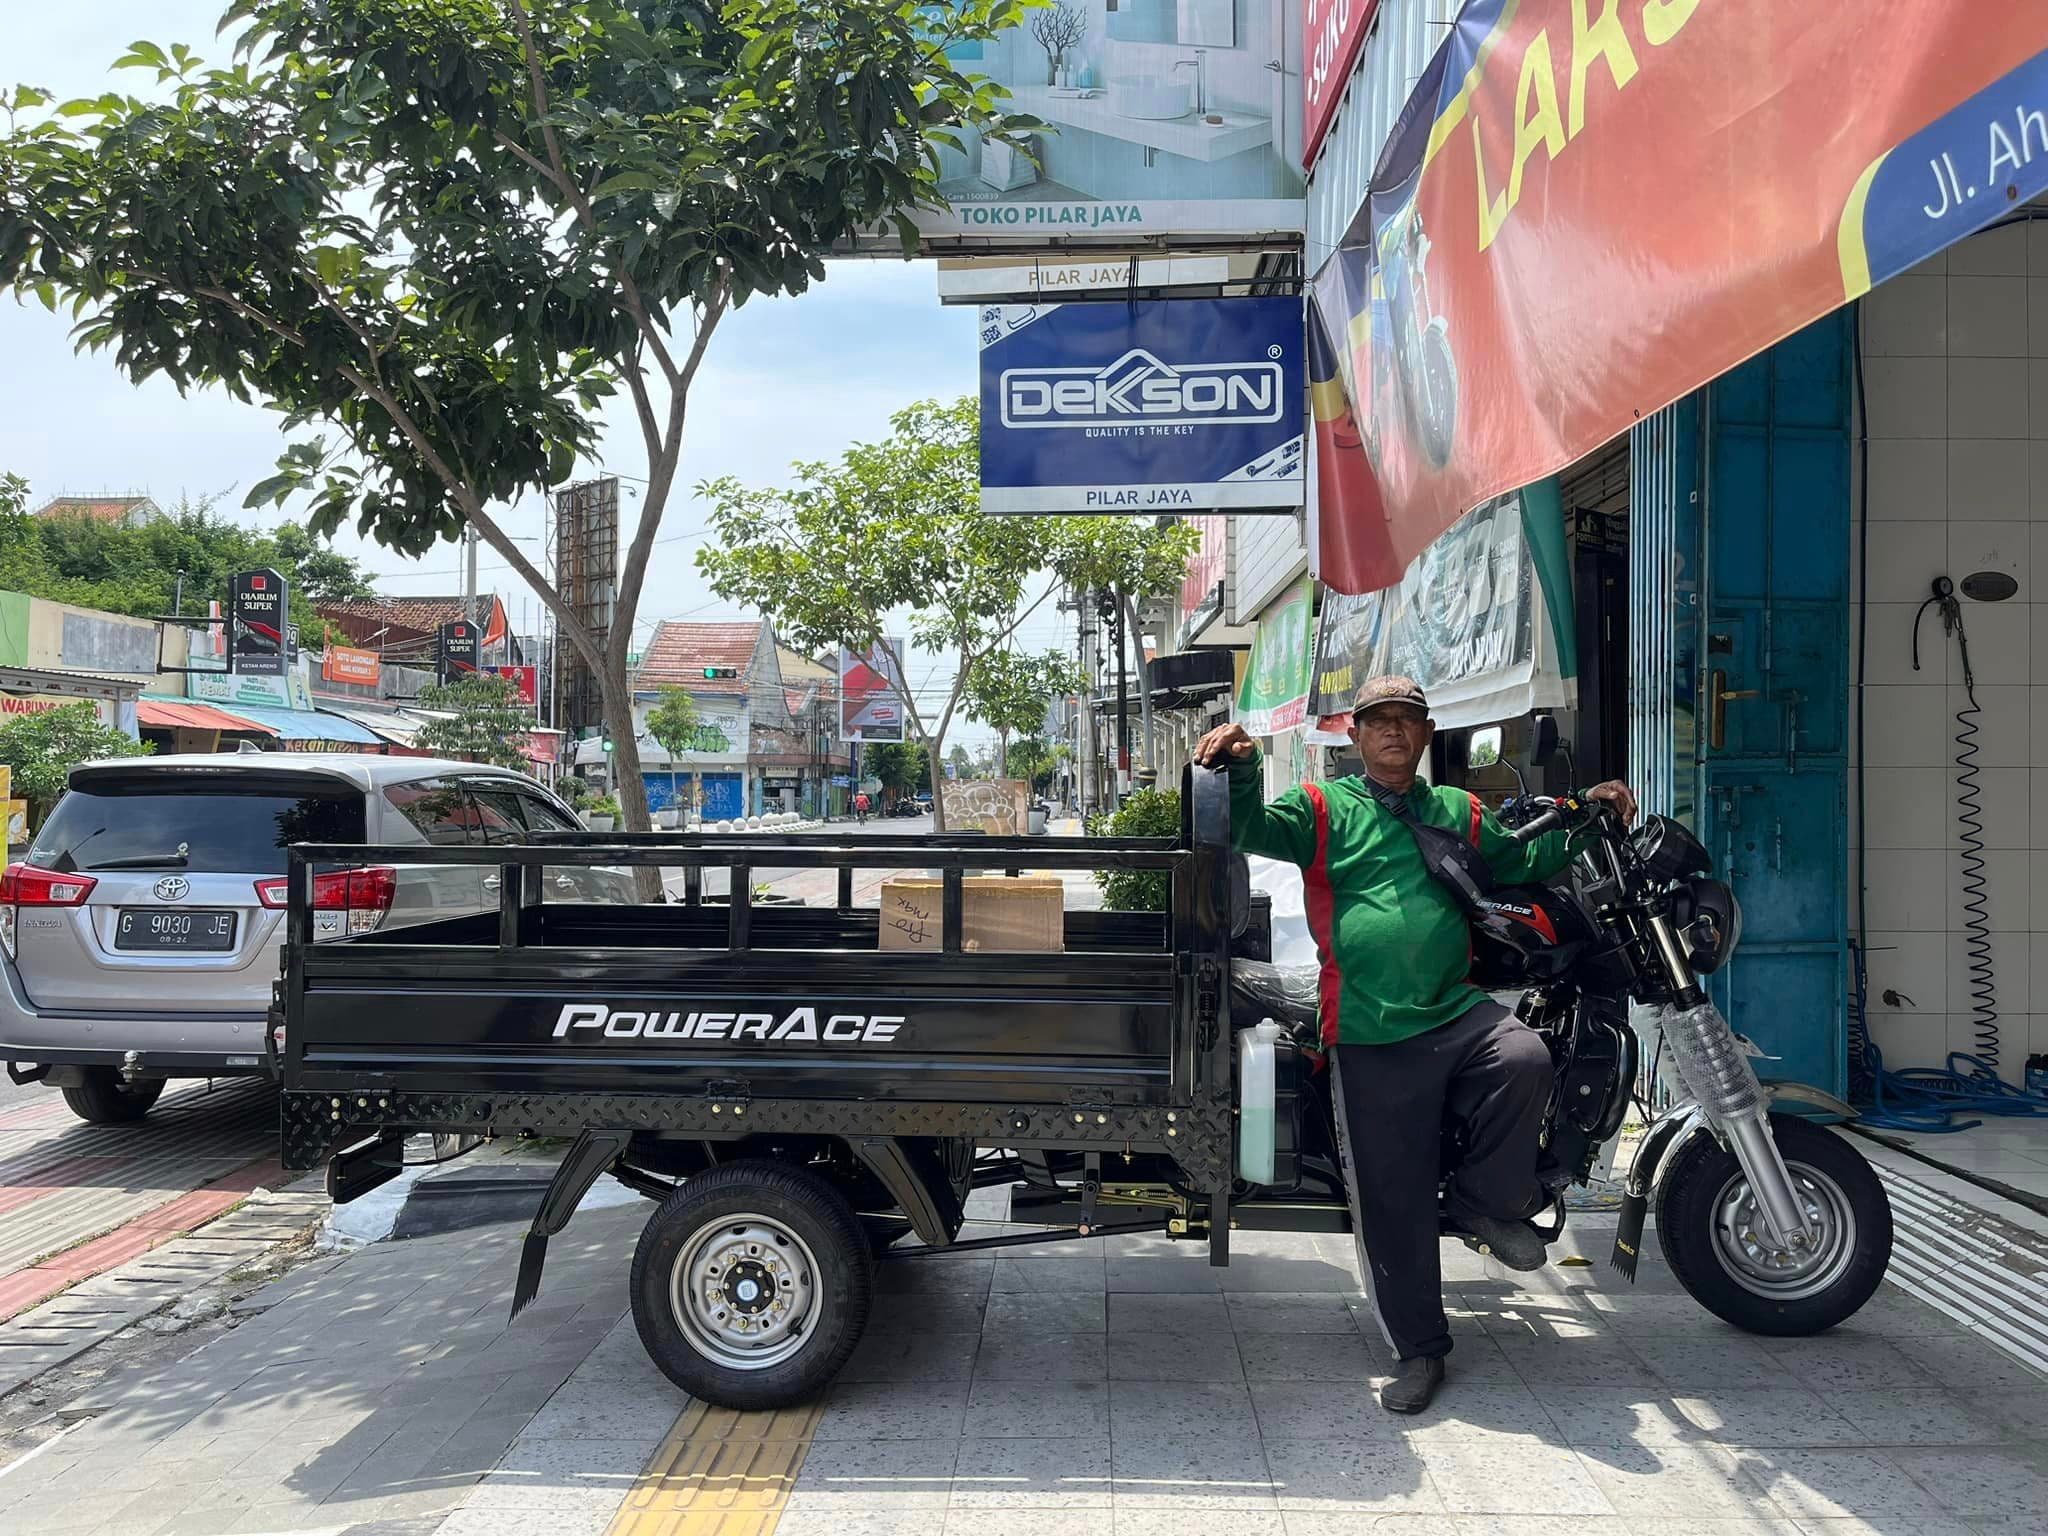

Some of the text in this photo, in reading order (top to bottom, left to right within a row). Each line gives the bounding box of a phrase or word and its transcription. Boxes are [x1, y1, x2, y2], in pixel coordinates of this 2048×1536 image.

[1923, 151, 1976, 219] Jl.
[960, 205, 1143, 227] TOKO PILAR JAYA
[1028, 267, 1132, 286] PILAR JAYA
[1085, 425, 1195, 438] QUALITY IS THE KEY
[1086, 489, 1193, 505] PILAR JAYA
[243, 601, 273, 610] SUPER
[122, 915, 229, 935] G 9030 JE
